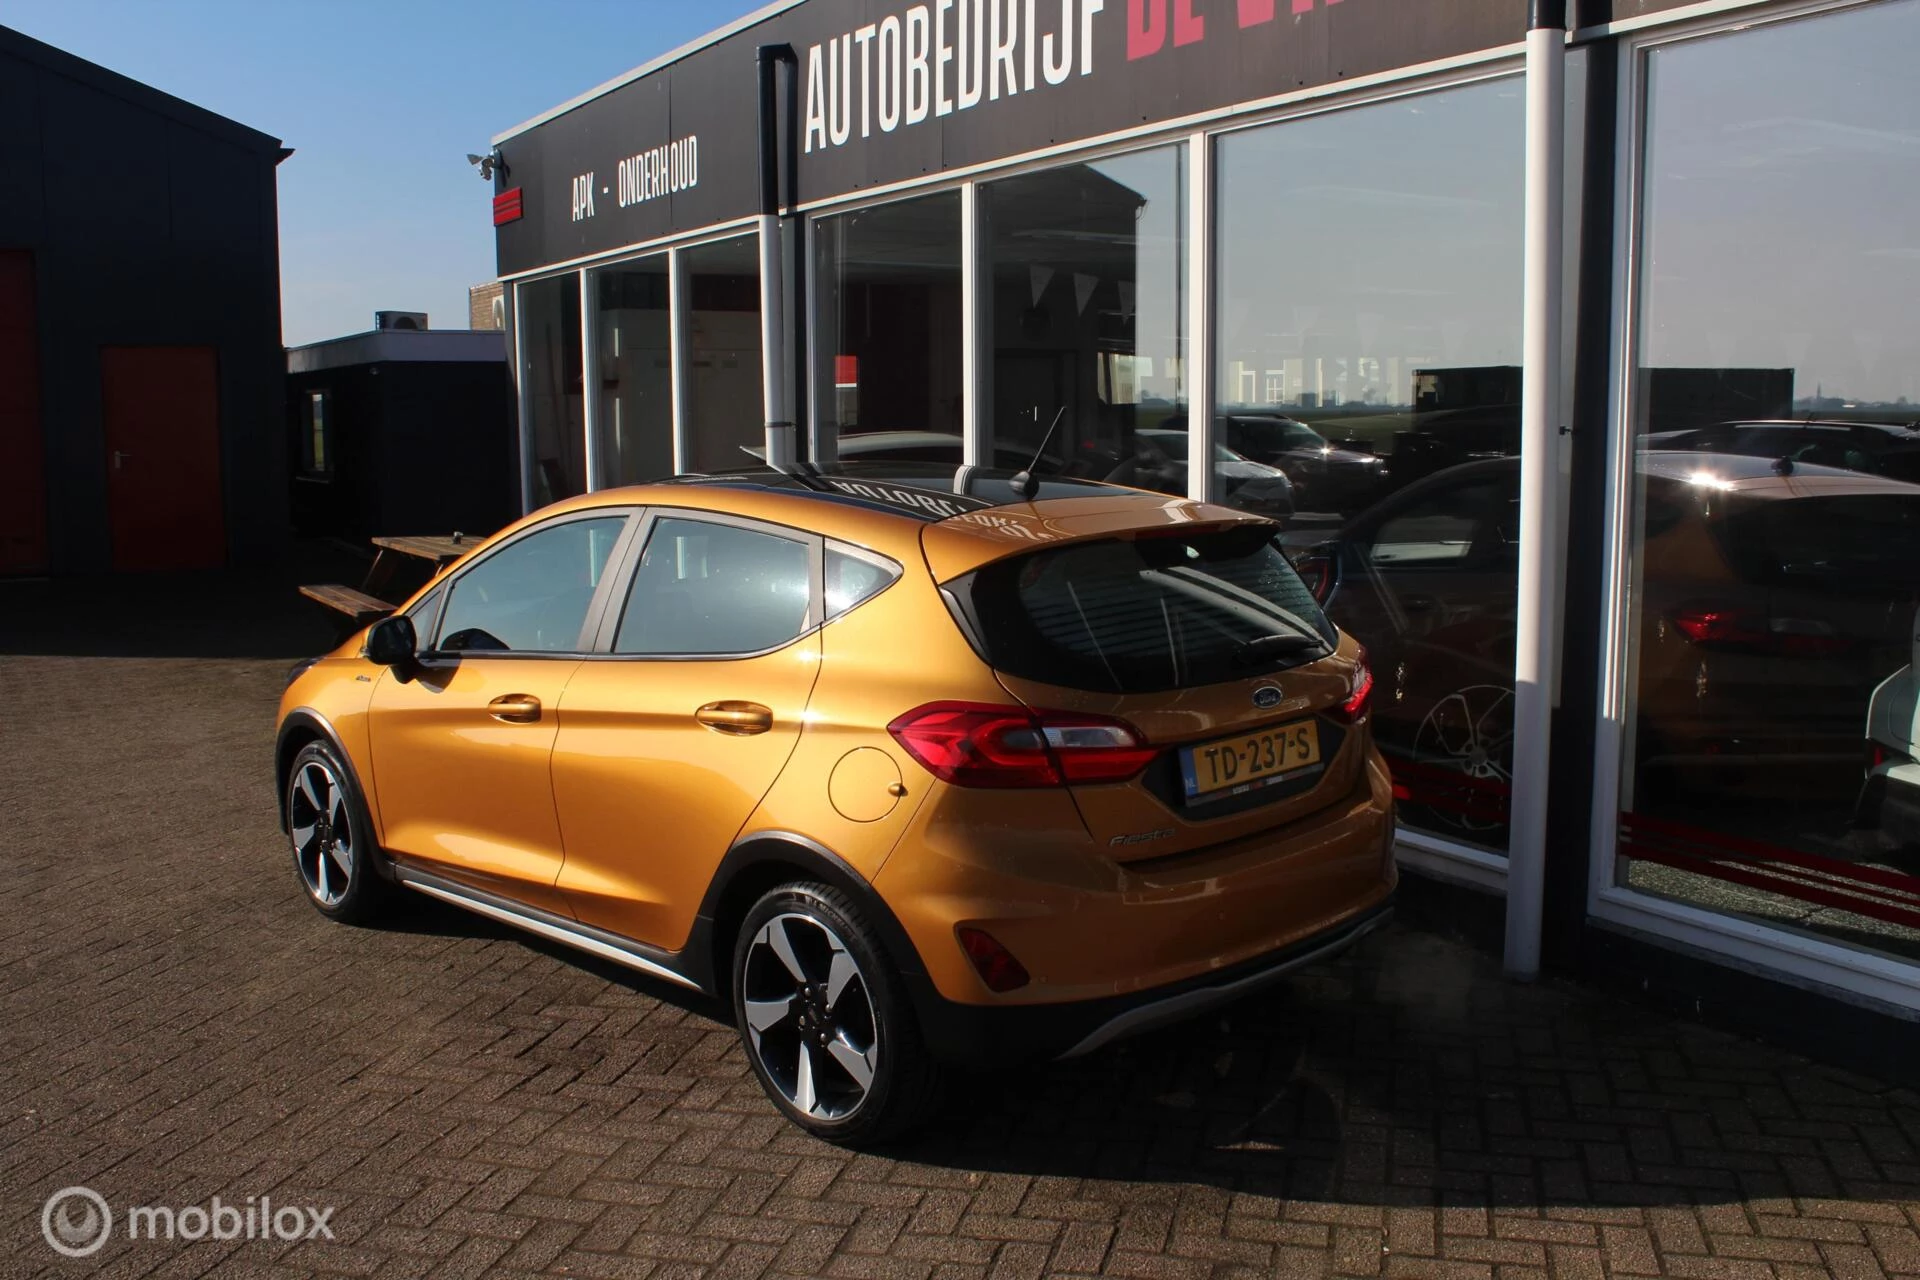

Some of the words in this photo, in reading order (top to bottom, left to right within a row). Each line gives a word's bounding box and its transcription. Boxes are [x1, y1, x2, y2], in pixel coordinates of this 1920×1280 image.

[804, 0, 1104, 154] AUTOBEDRIJF
[572, 171, 595, 222] APK
[618, 135, 697, 208] ONDERHOUD
[1204, 727, 1310, 784] TD-237-S
[1110, 828, 1176, 847] Fiesta
